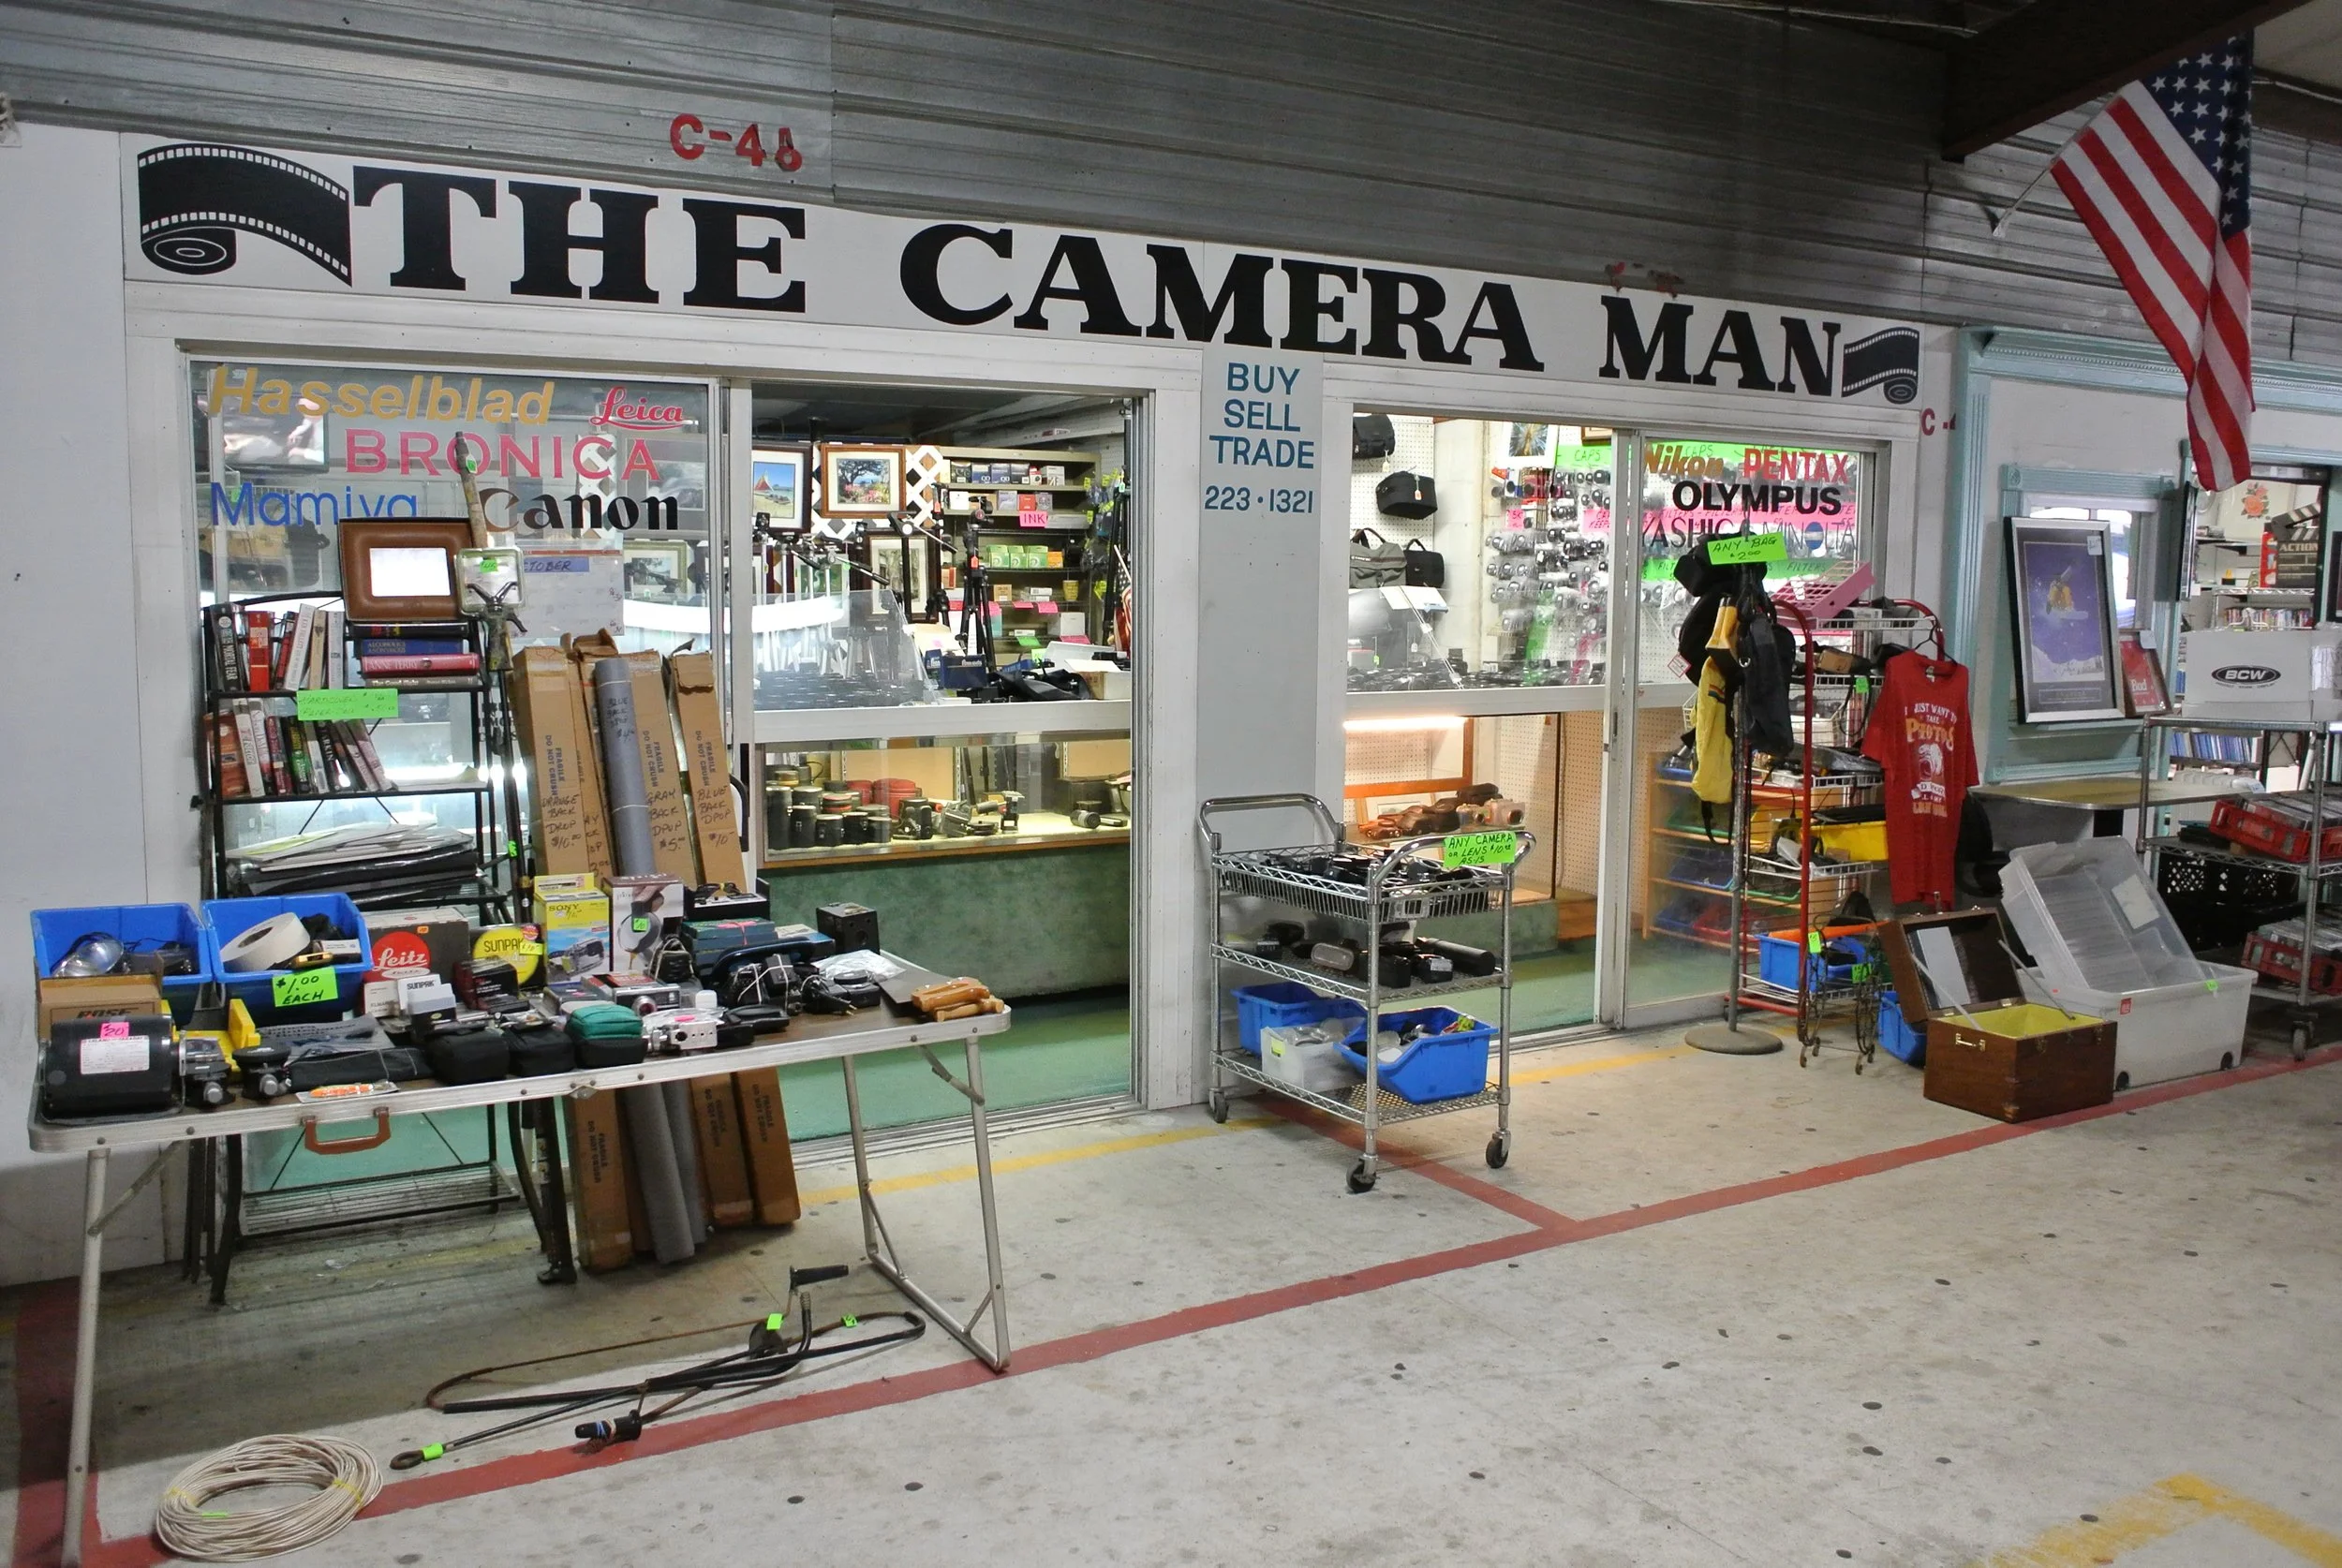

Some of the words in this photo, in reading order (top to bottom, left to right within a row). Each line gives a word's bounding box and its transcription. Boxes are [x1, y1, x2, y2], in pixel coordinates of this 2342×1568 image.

[352, 165, 806, 313] THE
[899, 223, 1544, 372] CAMERA
[1600, 295, 1842, 397] MAN
[1227, 362, 1300, 395] BUY
[209, 365, 555, 425] Hasselblad
[588, 387, 691, 431] Leica
[1224, 399, 1301, 432] SELL
[345, 428, 660, 481] BRONICA
[1209, 435, 1314, 469] TRADE
[1644, 443, 1724, 477] Nikon
[1742, 448, 1849, 483] PENTAX
[211, 482, 418, 525] Mamiya
[481, 488, 678, 532] Canon
[1672, 481, 1842, 515] OLYMPUS
[1023, 514, 1045, 525] INK
[1712, 540, 1742, 553] ANY
[1751, 537, 1777, 548] BAG
[2130, 679, 2147, 690] Bud
[2225, 670, 2265, 680] BCW
[1914, 703, 1930, 713] JUST
[1931, 703, 1949, 718] WANT
[545, 734, 552, 746] DO
[546, 747, 555, 765] NOT
[556, 747, 565, 782] FRAGILE
[643, 731, 649, 742] DO
[647, 761, 659, 787] CRUSH
[654, 741, 664, 774] FRAGILE
[695, 731, 702, 741] DO
[700, 760, 709, 786] CRUSH
[706, 741, 716, 773] FRAGILE
[549, 766, 557, 795] CRUSH
[546, 820, 576, 834] DROP
[1448, 836, 1471, 849] ANY
[1475, 833, 1513, 845] CAMERA
[1461, 846, 1488, 857] LENS
[548, 903, 579, 912] SONY
[372, 947, 428, 971] Leitz
[483, 938, 525, 953] SUNPAK
[282, 989, 324, 1004] EACH
[407, 980, 435, 990] SUNPAK
